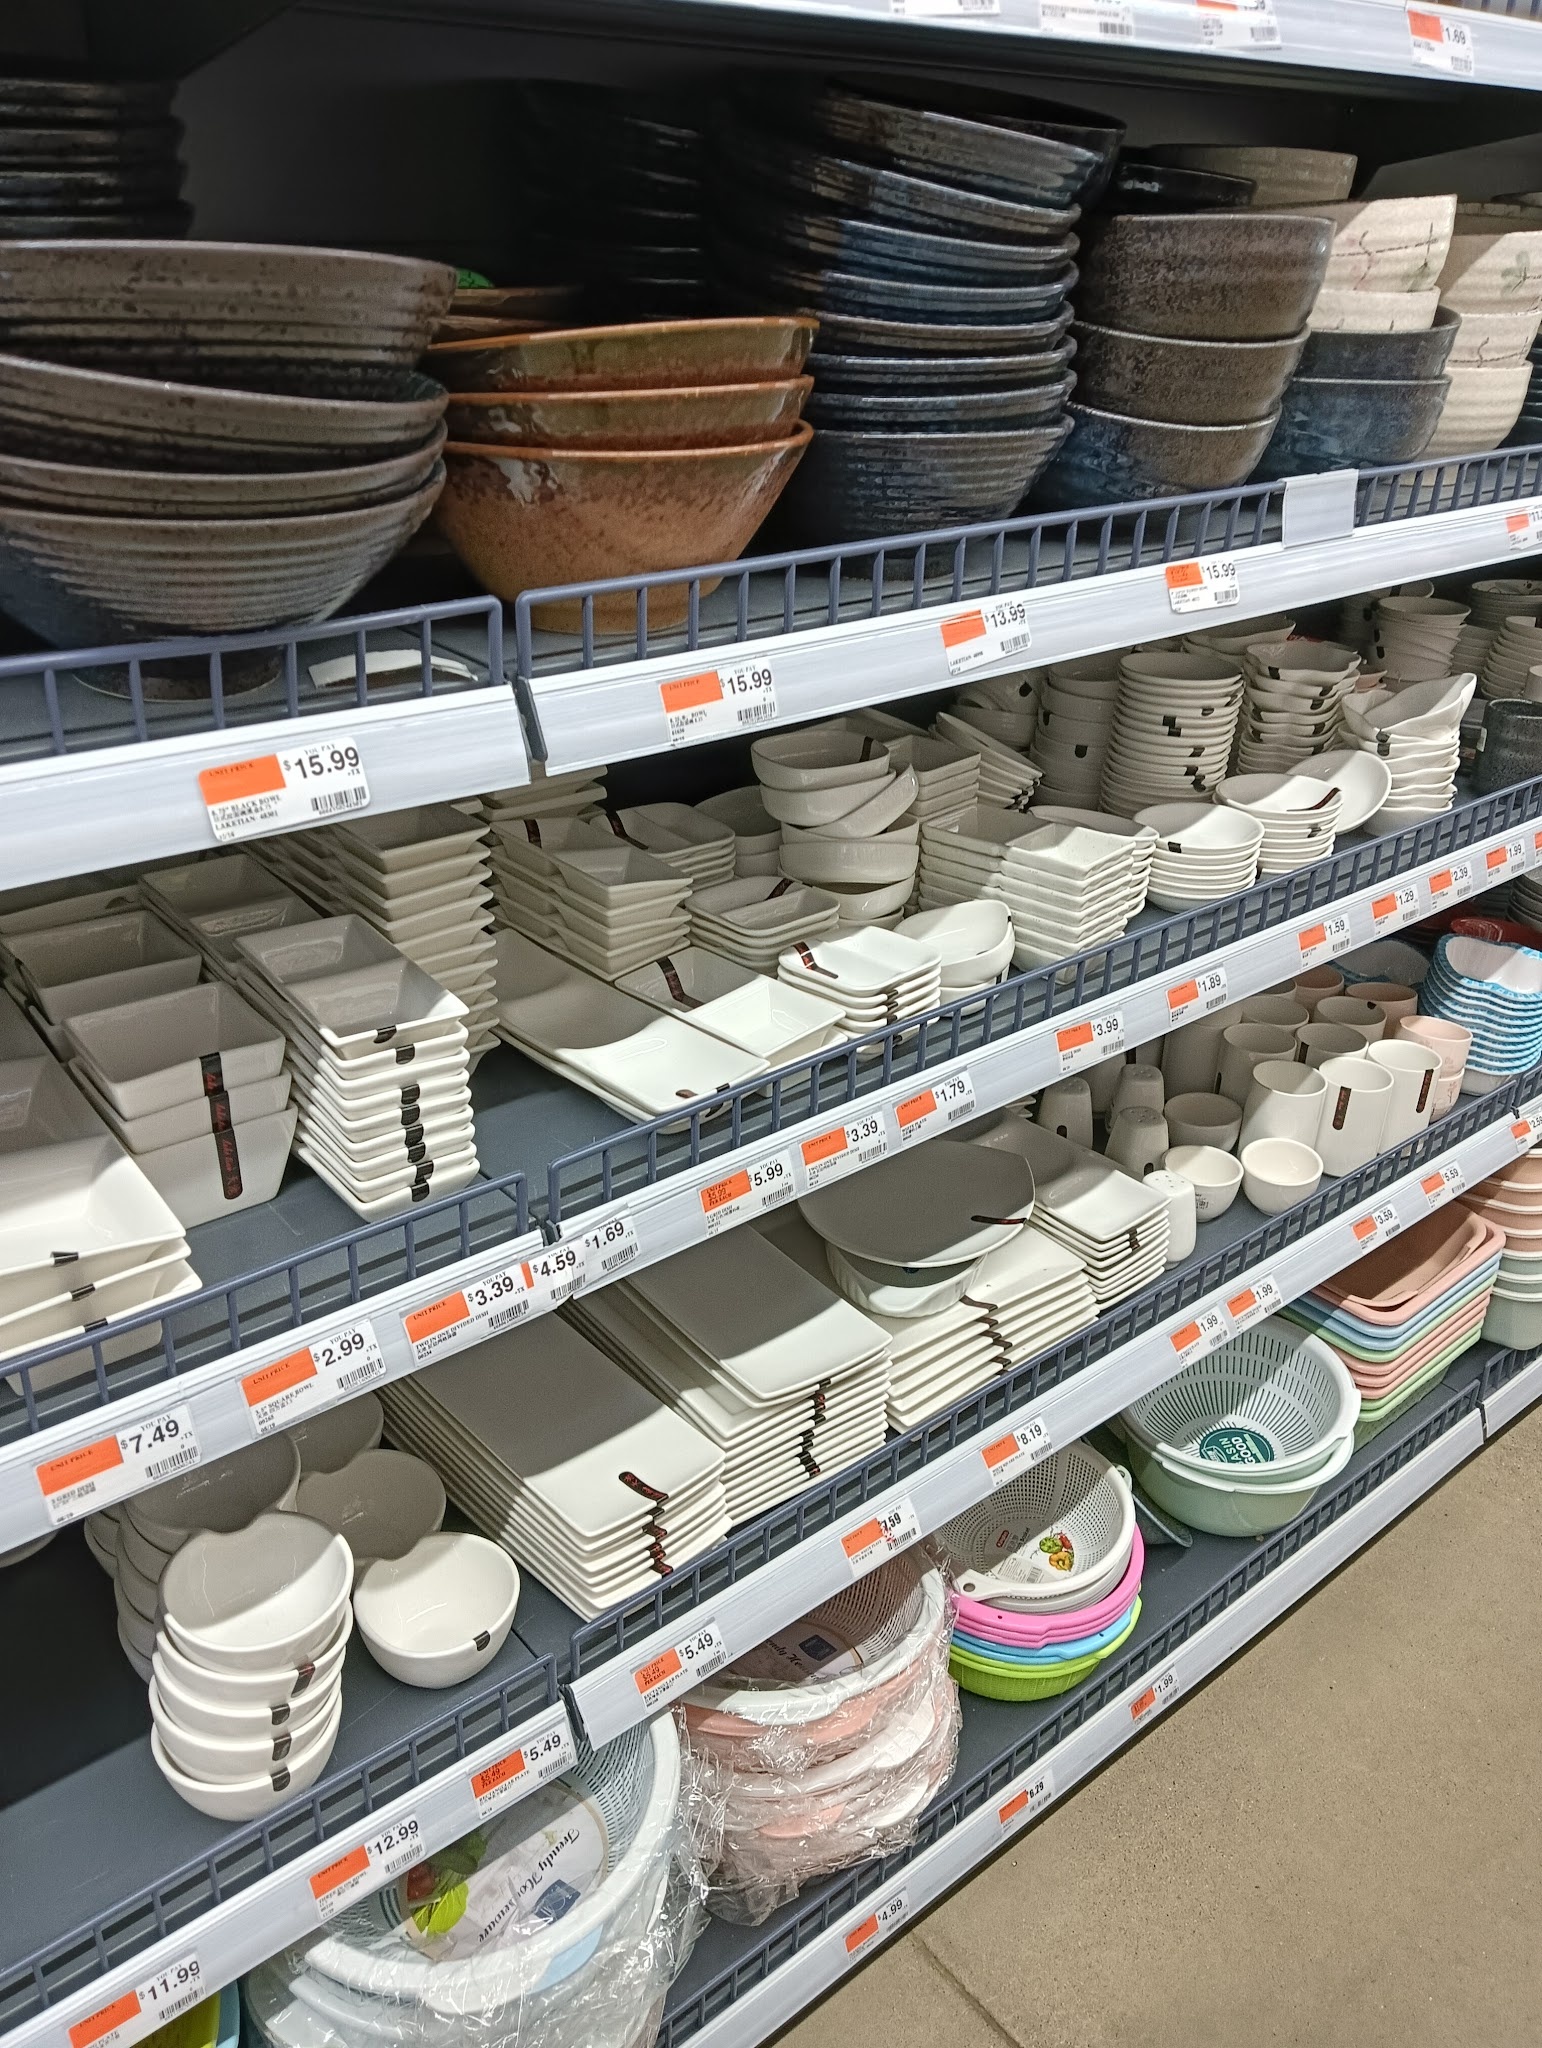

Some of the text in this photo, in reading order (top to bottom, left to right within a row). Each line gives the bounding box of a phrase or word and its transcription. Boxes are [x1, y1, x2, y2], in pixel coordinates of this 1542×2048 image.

[985, 604, 1026, 628] $13.99
[720, 668, 773, 695] $15.99
[321, 744, 336, 754] PAY
[283, 746, 360, 779] $15.99
[231, 800, 258, 812] BLACK
[258, 794, 282, 806] BOWL
[215, 817, 256, 831] LAKETIAN
[1093, 1018, 1119, 1036] $3.99
[935, 1080, 965, 1102] $1.79
[846, 1120, 878, 1143] $3.39
[748, 1163, 783, 1187] $5.99
[585, 1222, 624, 1250] $1.69
[495, 1271, 507, 1281] PAY
[533, 1250, 576, 1277] $4.59
[467, 1275, 514, 1307] $3.39
[428, 1301, 446, 1314] PRICE
[330, 1327, 356, 1345] YOU PAY
[416, 1339, 430, 1350] TWO
[437, 1329, 450, 1341] ONE
[450, 1318, 476, 1335] DIVIDED
[476, 1310, 490, 1322] DISH
[313, 1333, 365, 1367] $2.99
[267, 1392, 295, 1409] SQUARE
[295, 1383, 314, 1396] BOWL
[141, 1413, 171, 1432] YOU PAY
[1016, 1424, 1042, 1445] $8.19
[120, 1419, 180, 1454] $7.49
[56, 1490, 76, 1503] GRID
[77, 1481, 95, 1495] DISH
[678, 1633, 714, 1660] $5.49
[523, 1734, 561, 1761] $5.49
[367, 1820, 419, 1855] $12.99
[538, 1828, 580, 1873] Trendy
[139, 1960, 200, 2001] $11.99
